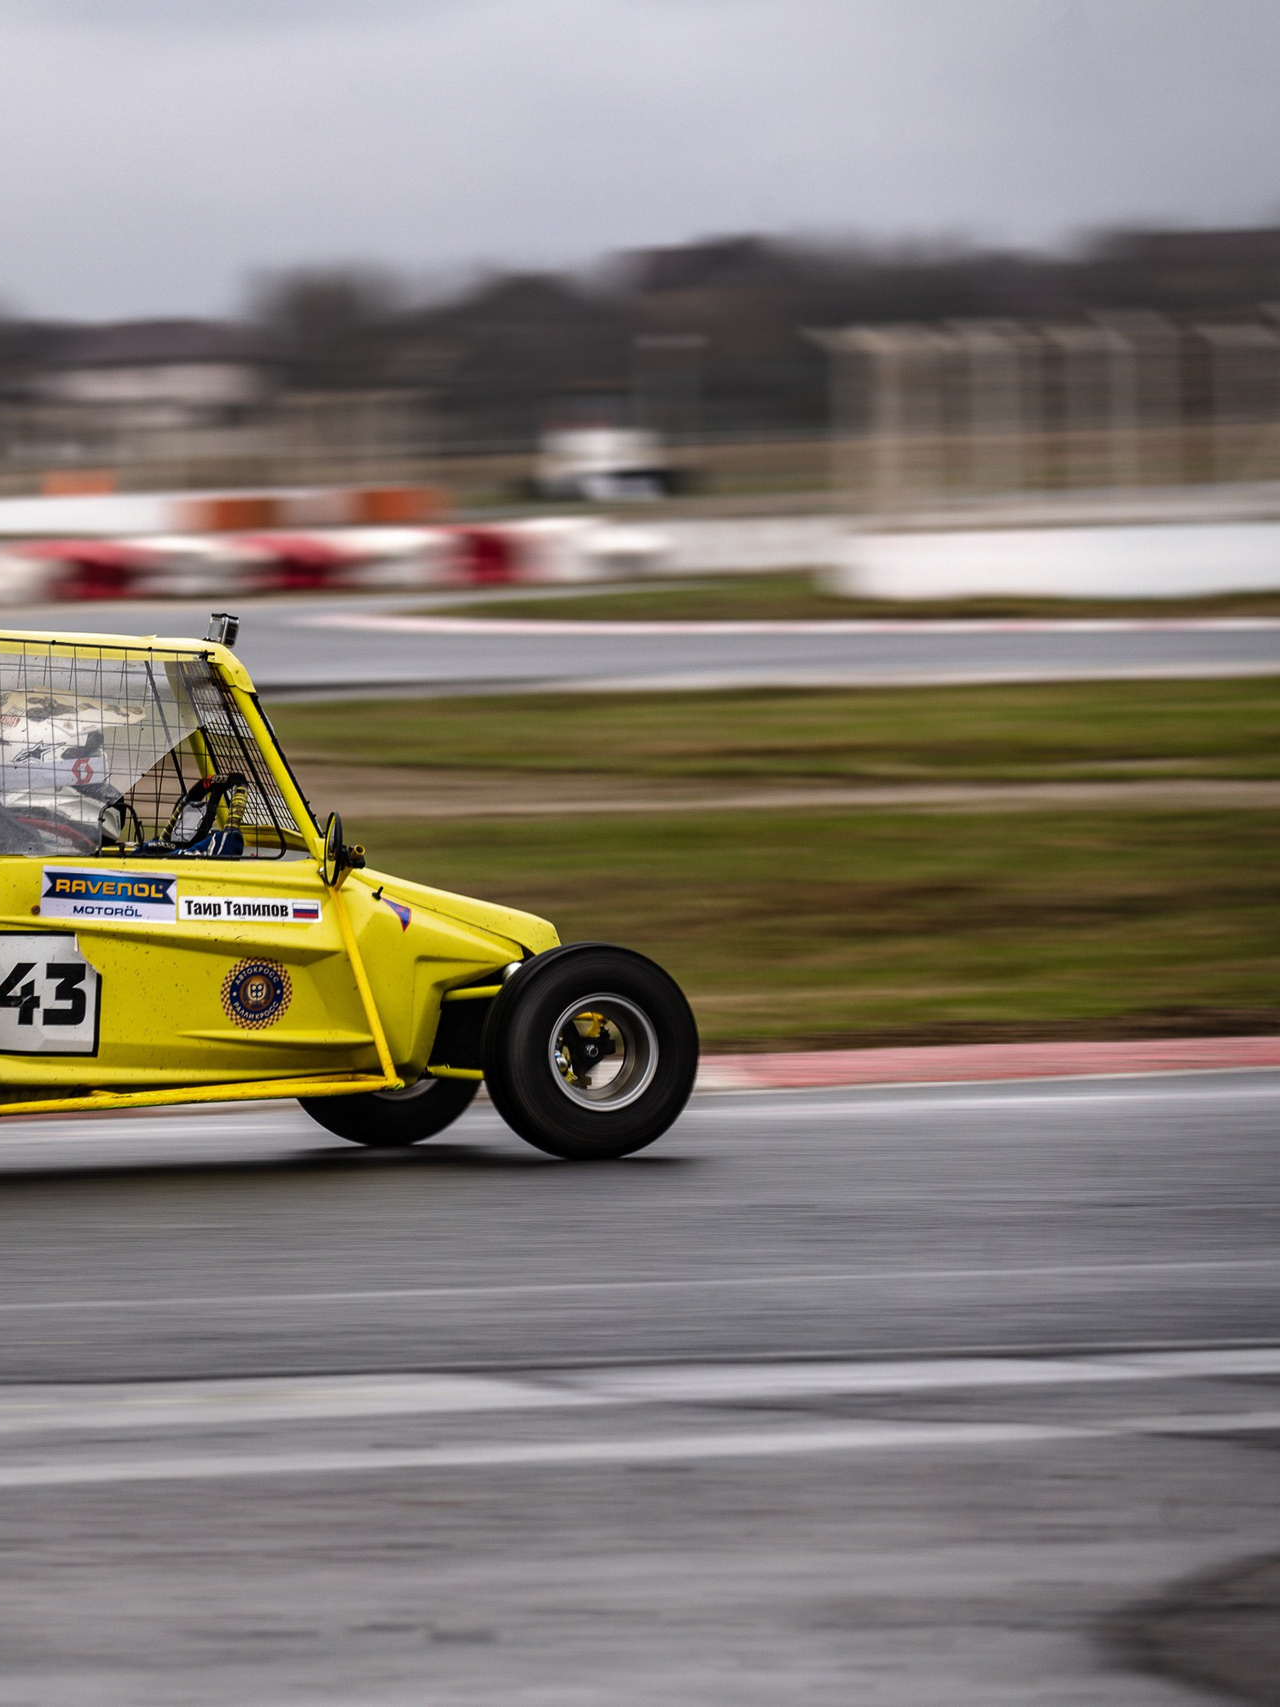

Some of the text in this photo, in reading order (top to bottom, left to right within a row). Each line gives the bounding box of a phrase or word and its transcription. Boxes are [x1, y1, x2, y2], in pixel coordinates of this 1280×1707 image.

[55, 878, 163, 898] RAVENOL
[72, 905, 143, 918] MOTORÖL
[185, 900, 289, 917] Таир Талипов
[235, 966, 279, 985] АВТОКРОСС
